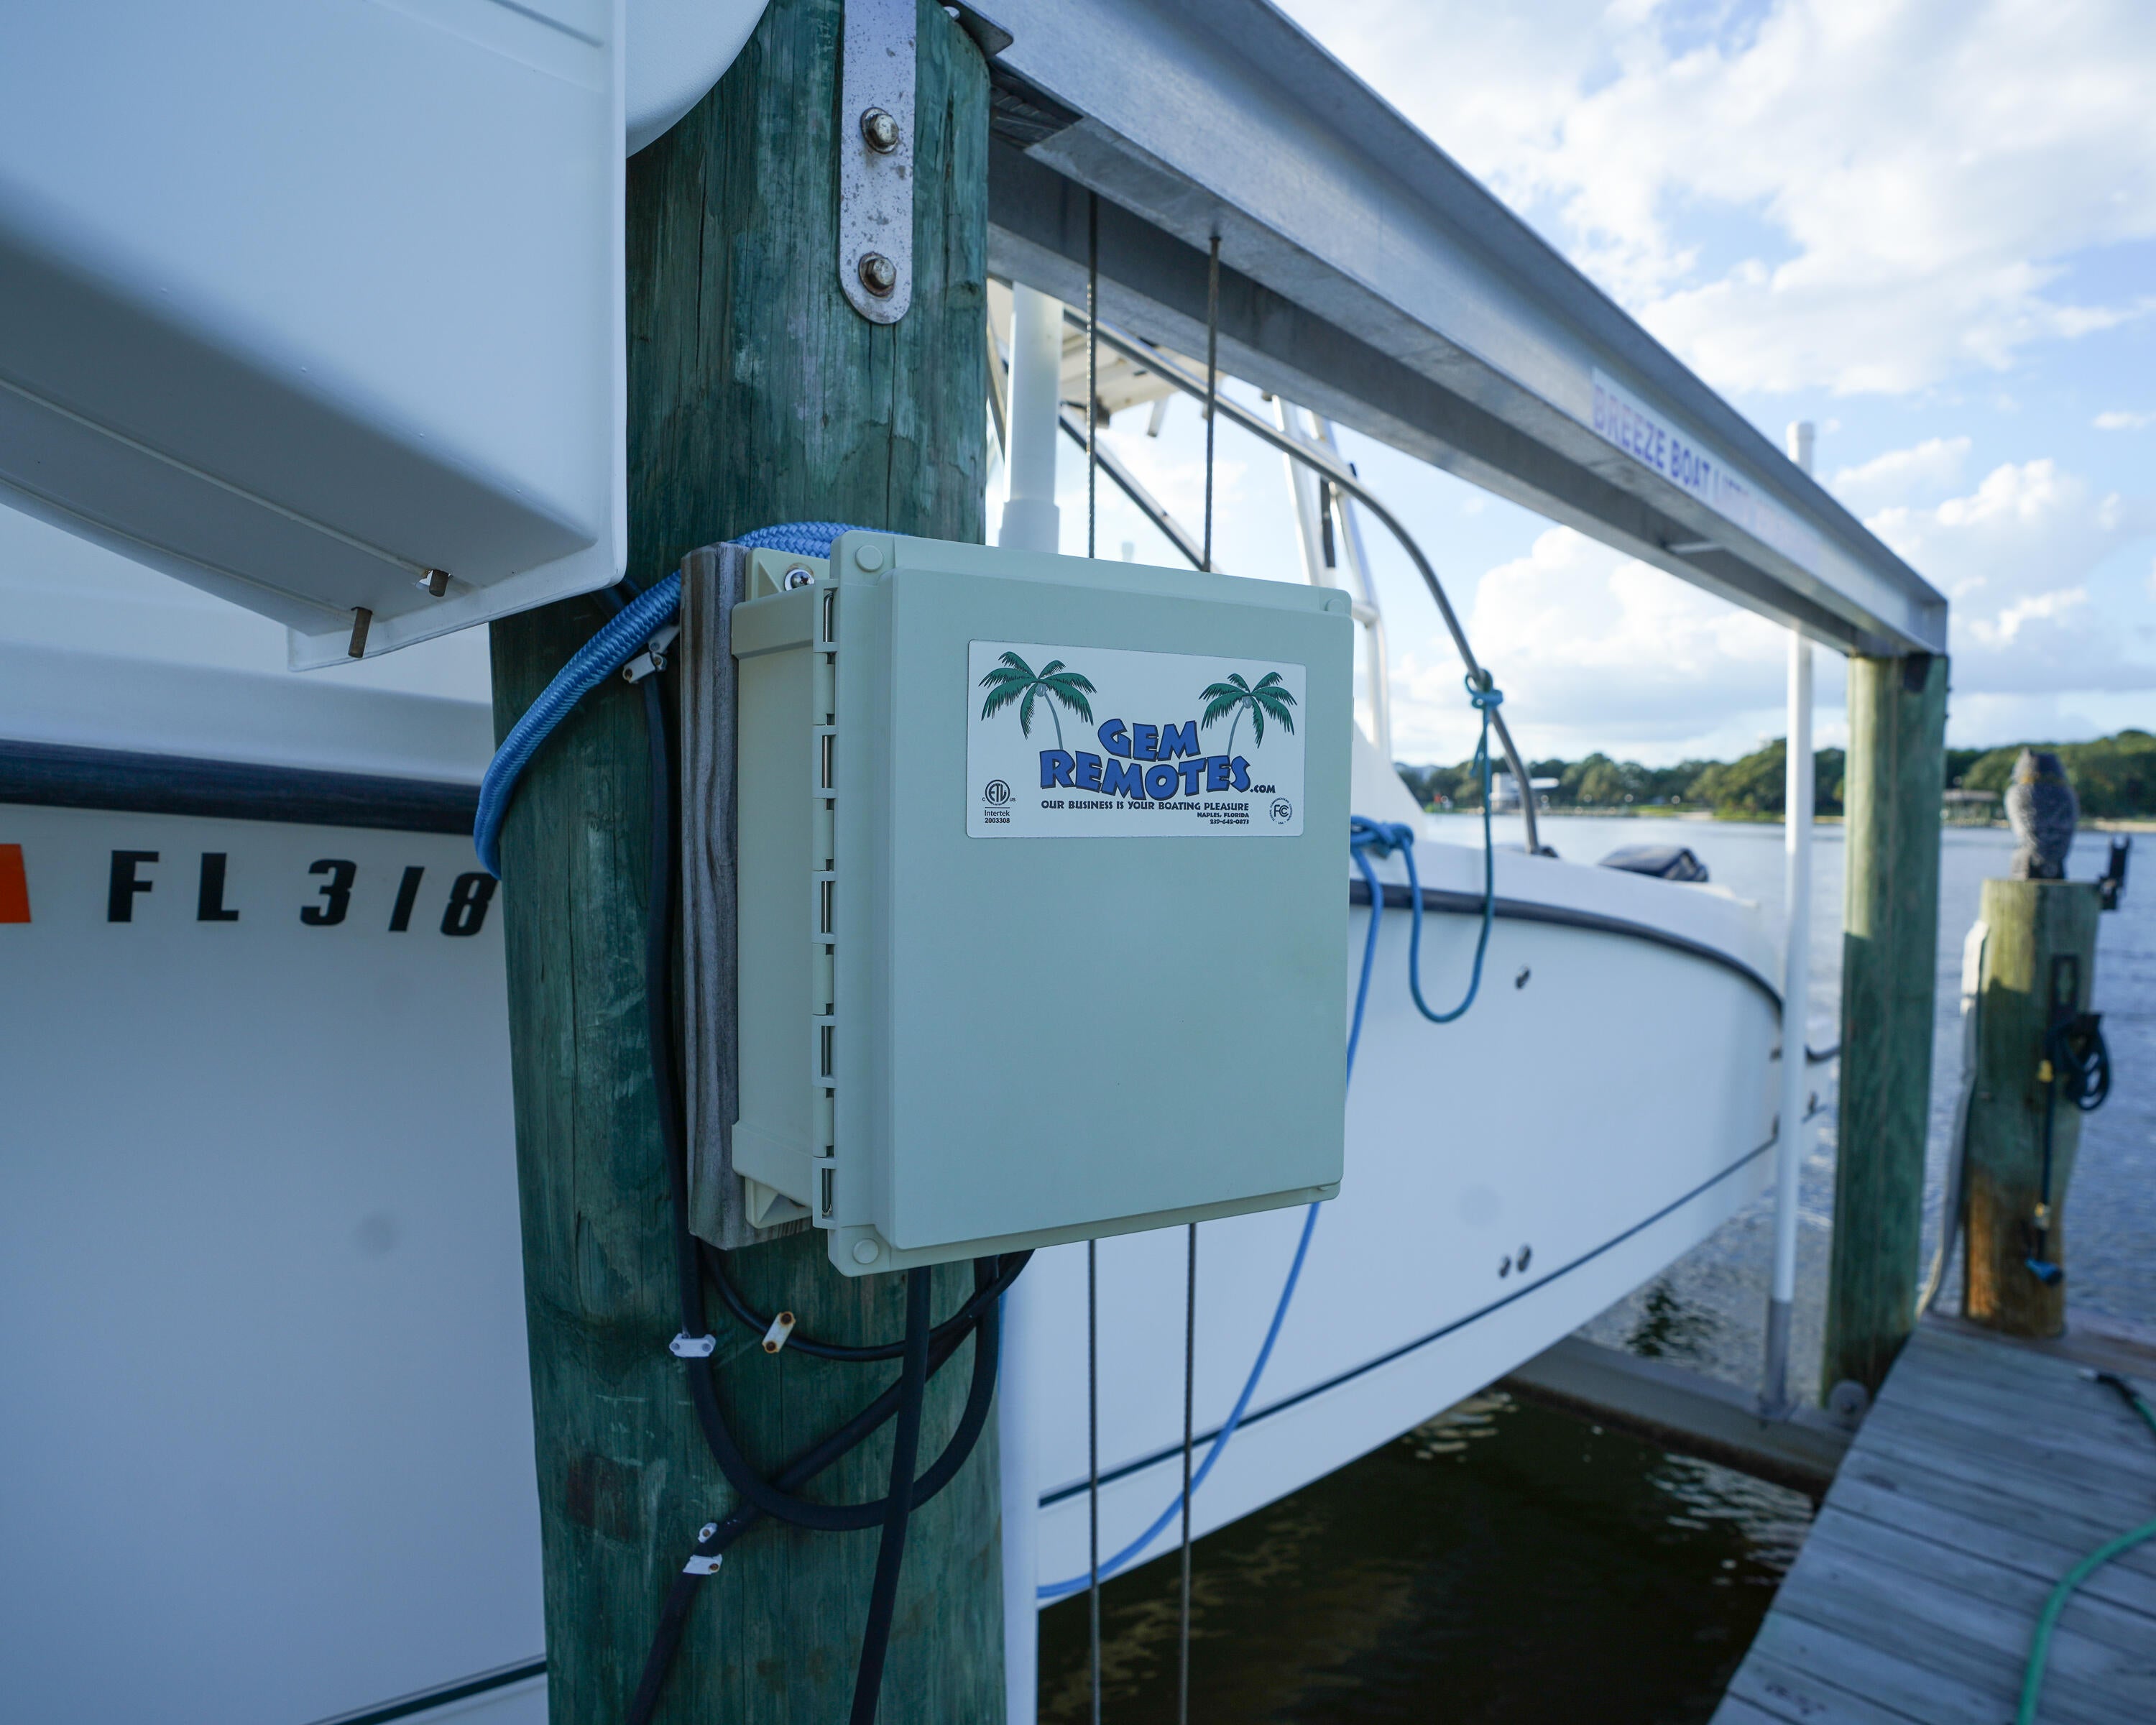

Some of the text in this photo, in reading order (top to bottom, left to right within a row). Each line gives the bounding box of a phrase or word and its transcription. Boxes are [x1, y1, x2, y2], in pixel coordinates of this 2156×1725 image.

[1593, 384, 1711, 497] BREEZE BOAT
[1097, 718, 1201, 763] GEM
[1039, 749, 1251, 801] REMOTES
[1041, 800, 1249, 811] OUR BUSINESS IS YOUR BOATING PLEASURE
[107, 850, 498, 937] FL 318
